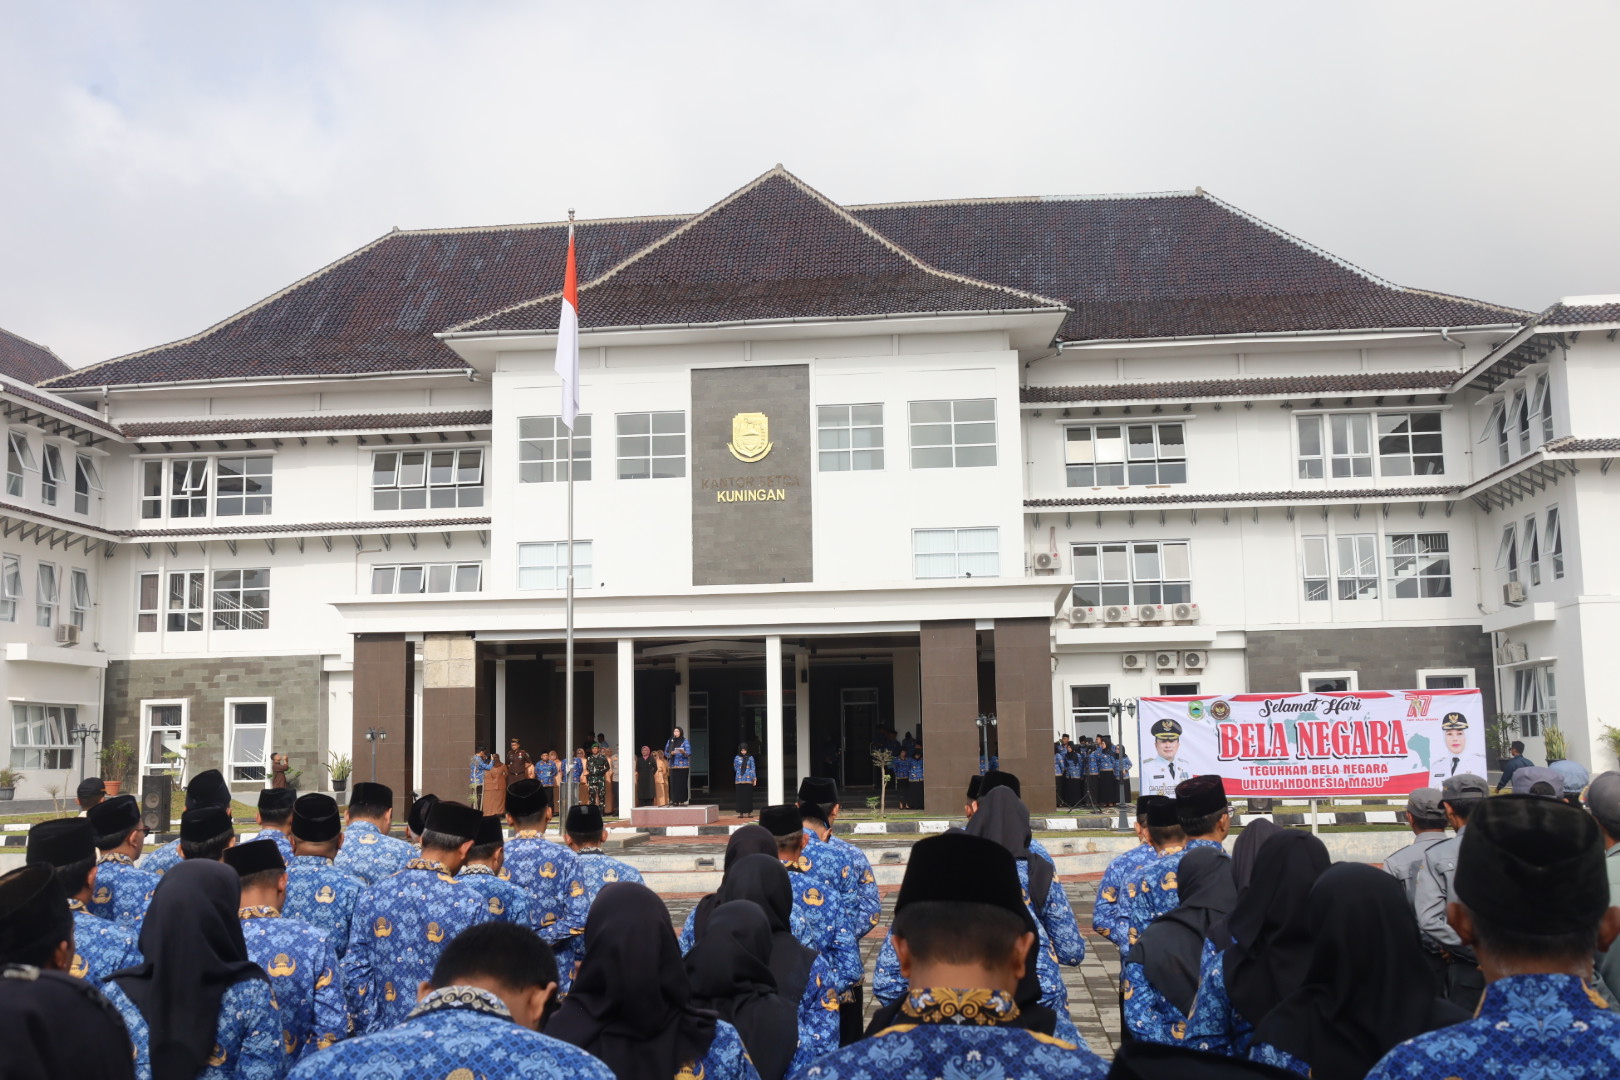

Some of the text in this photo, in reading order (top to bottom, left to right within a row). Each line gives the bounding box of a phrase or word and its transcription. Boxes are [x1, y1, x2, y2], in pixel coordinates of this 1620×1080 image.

[717, 489, 785, 502] KUNINGAN
[1259, 696, 1362, 717] Selamat Hari
[1218, 719, 1409, 761] BELA NEGARA
[1311, 764, 1339, 775] BELA
[1343, 763, 1389, 774] NEGARA
[1242, 779, 1279, 790] UNTUK
[1283, 778, 1346, 789] INDONESIA
